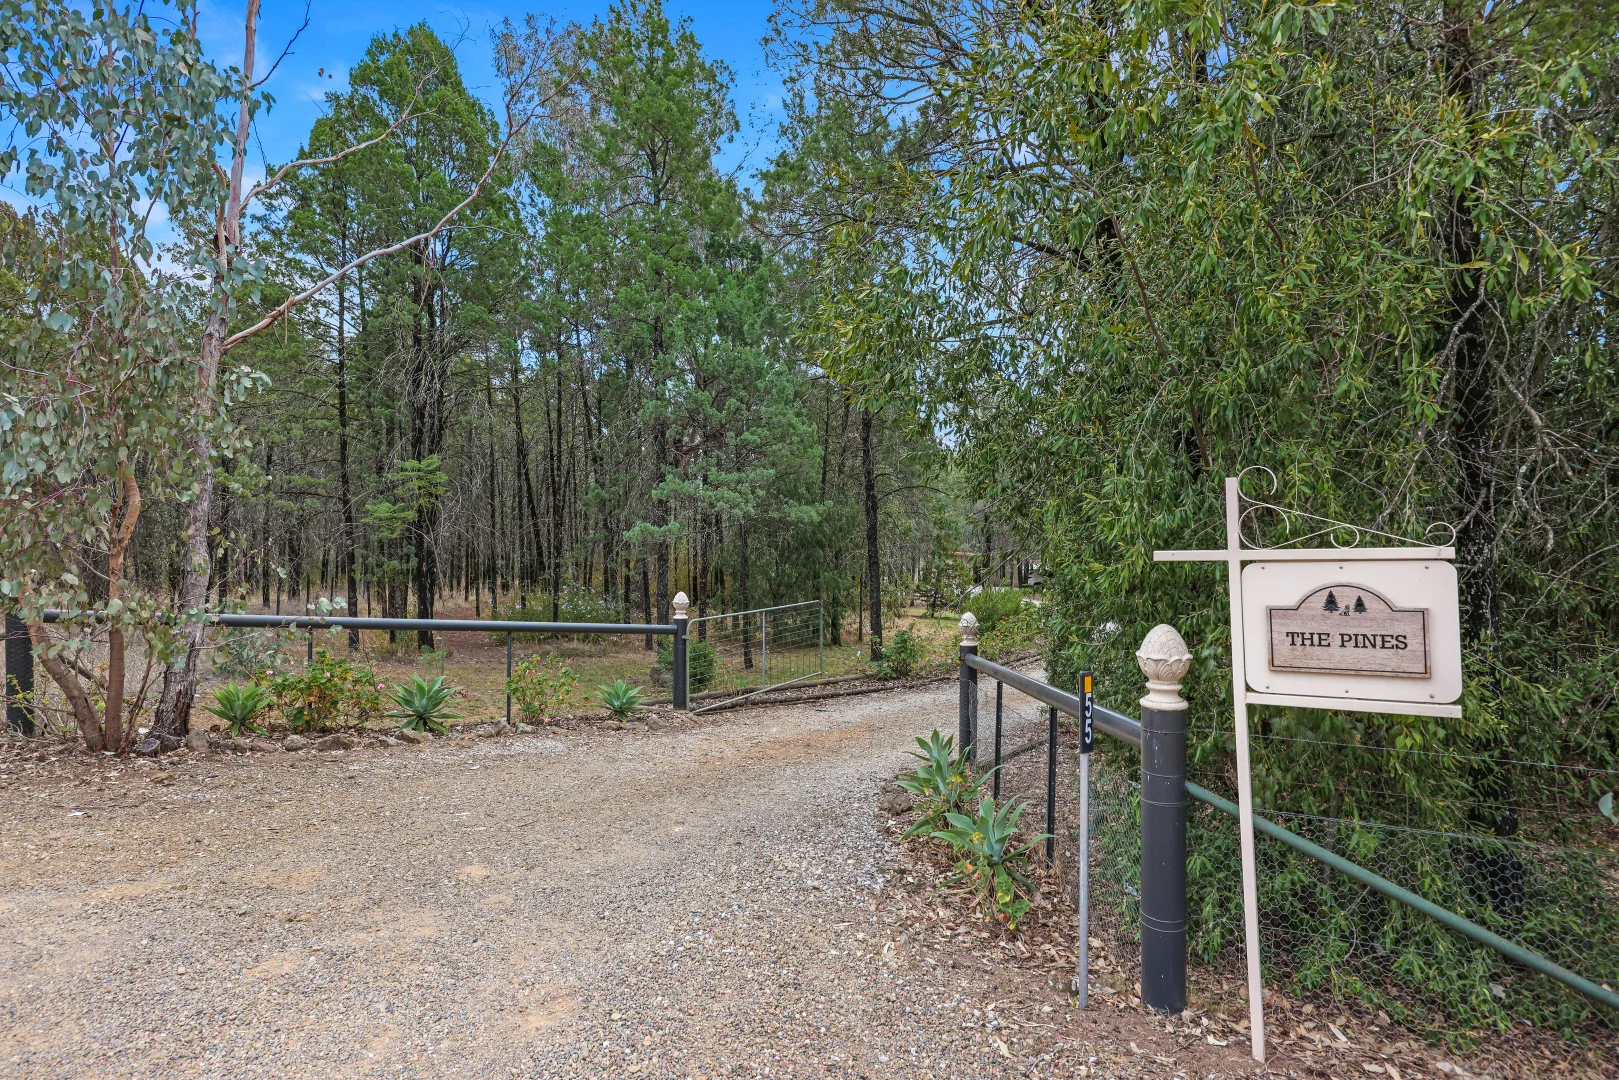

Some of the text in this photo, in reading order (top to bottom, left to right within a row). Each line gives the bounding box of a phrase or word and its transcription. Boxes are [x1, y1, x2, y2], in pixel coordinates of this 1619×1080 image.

[1286, 632, 1408, 650] THE PINES
[1085, 693, 1092, 744] 55
